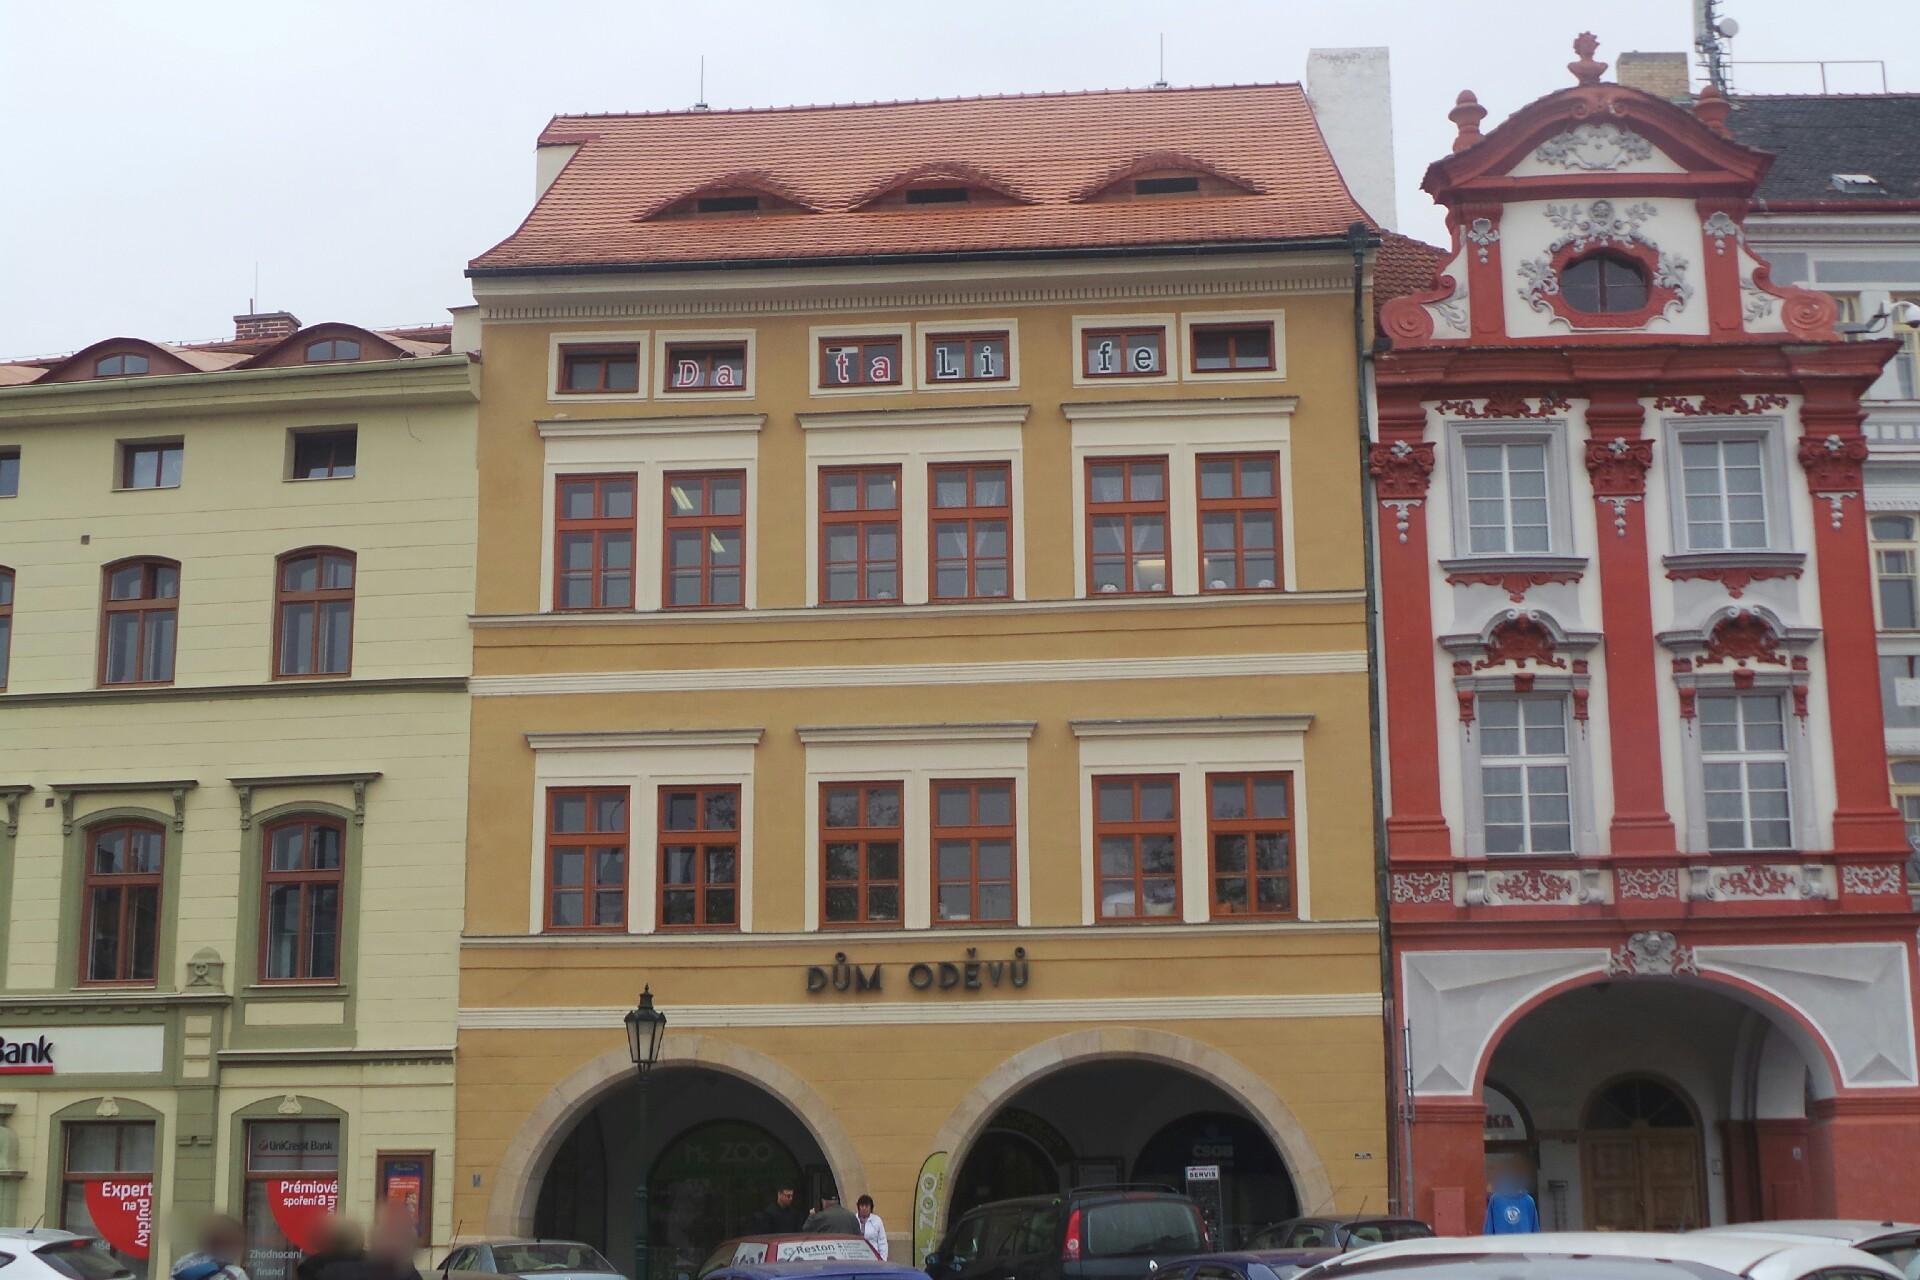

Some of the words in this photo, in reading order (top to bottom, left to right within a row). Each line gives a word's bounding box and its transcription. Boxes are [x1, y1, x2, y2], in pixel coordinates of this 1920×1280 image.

[807, 951, 882, 992] DŮM
[908, 946, 1029, 990] ODĚVŮ
[311, 1140, 333, 1150] Bank
[102, 1181, 153, 1201] Expert
[281, 1180, 338, 1194] Prémiové
[123, 1201, 137, 1211] na
[318, 1194, 326, 1206] a
[796, 1244, 836, 1255] Reston
